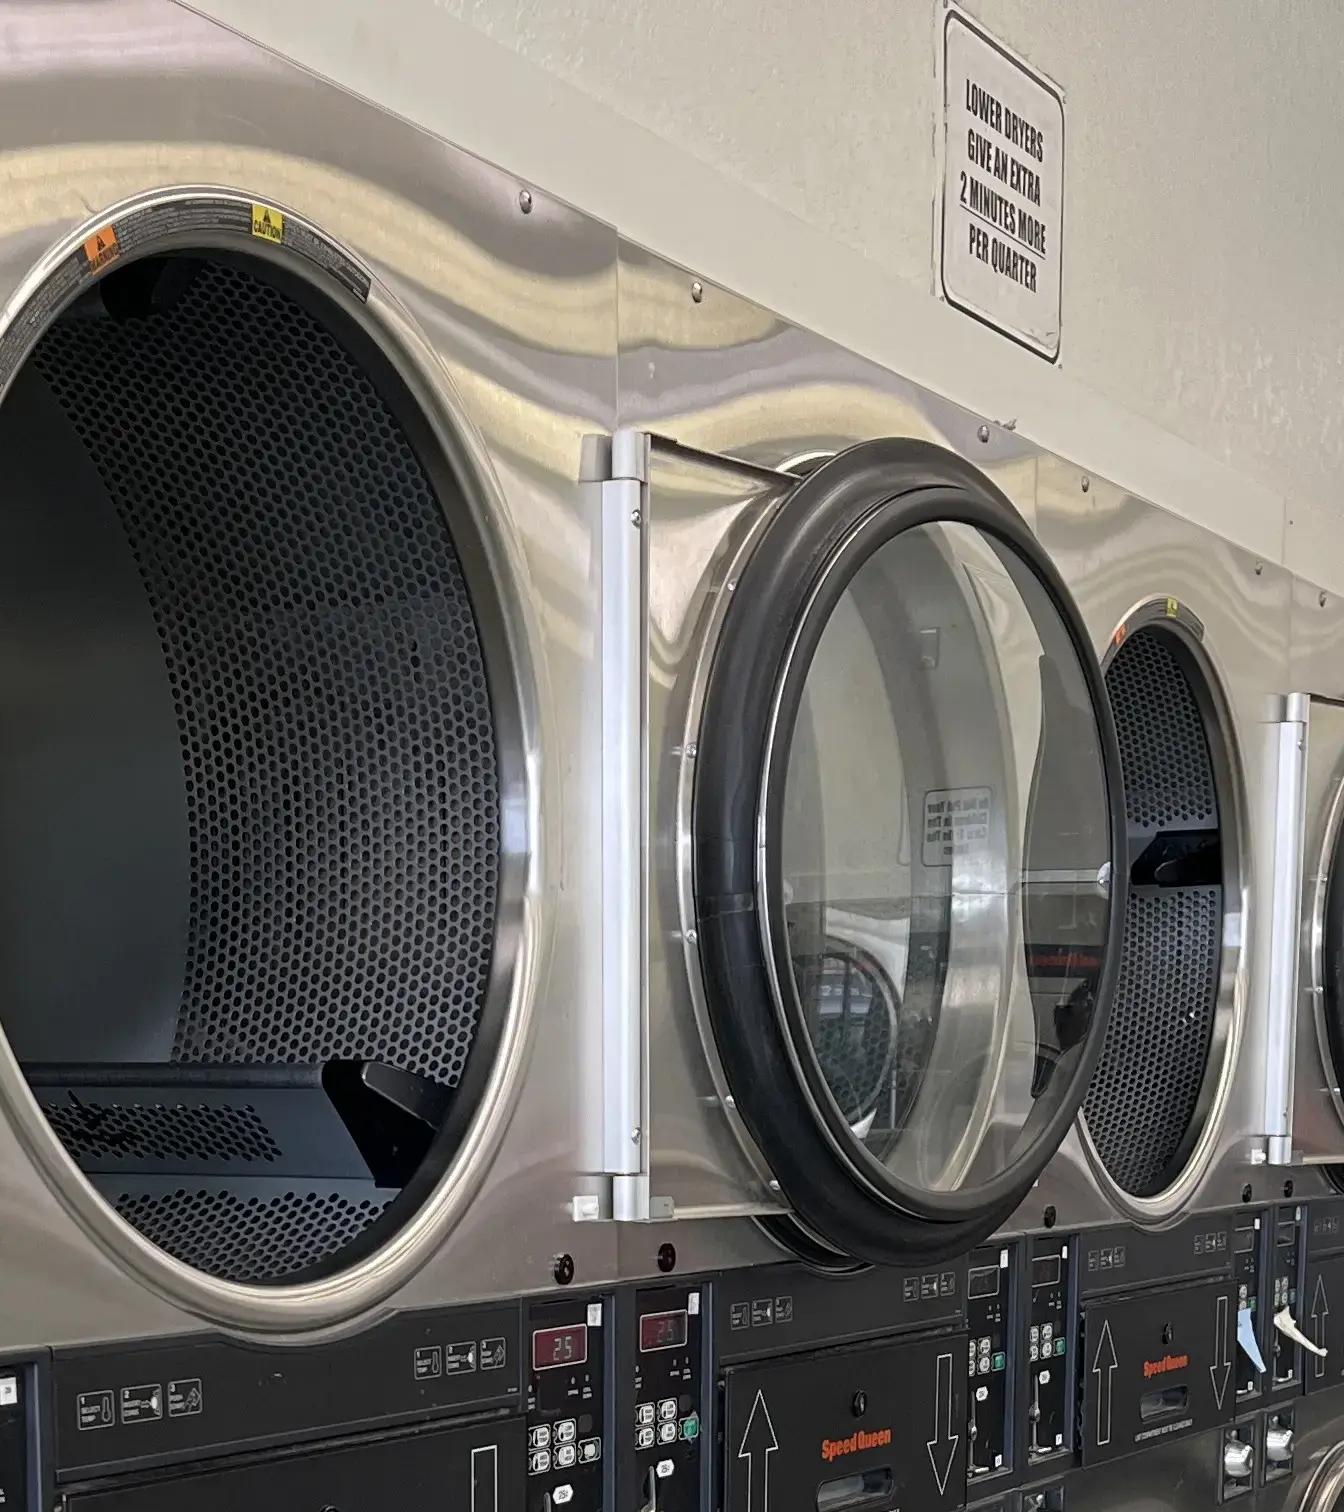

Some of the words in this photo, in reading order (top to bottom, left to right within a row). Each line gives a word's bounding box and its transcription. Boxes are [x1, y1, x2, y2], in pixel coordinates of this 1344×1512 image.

[966, 79, 1002, 134] LOWER
[1005, 106, 1044, 163] DRYERS
[968, 128, 992, 174] GIVE
[993, 146, 1008, 184] AN
[1010, 161, 1041, 207] EXTRA
[960, 171, 967, 204] 2
[969, 181, 1016, 235] MINUTES
[1018, 208, 1046, 254] MORE
[969, 223, 989, 265] PER
[991, 242, 1037, 293] QUARTER
[822, 1432, 857, 1462] Speed
[858, 1429, 892, 1449] Queen
